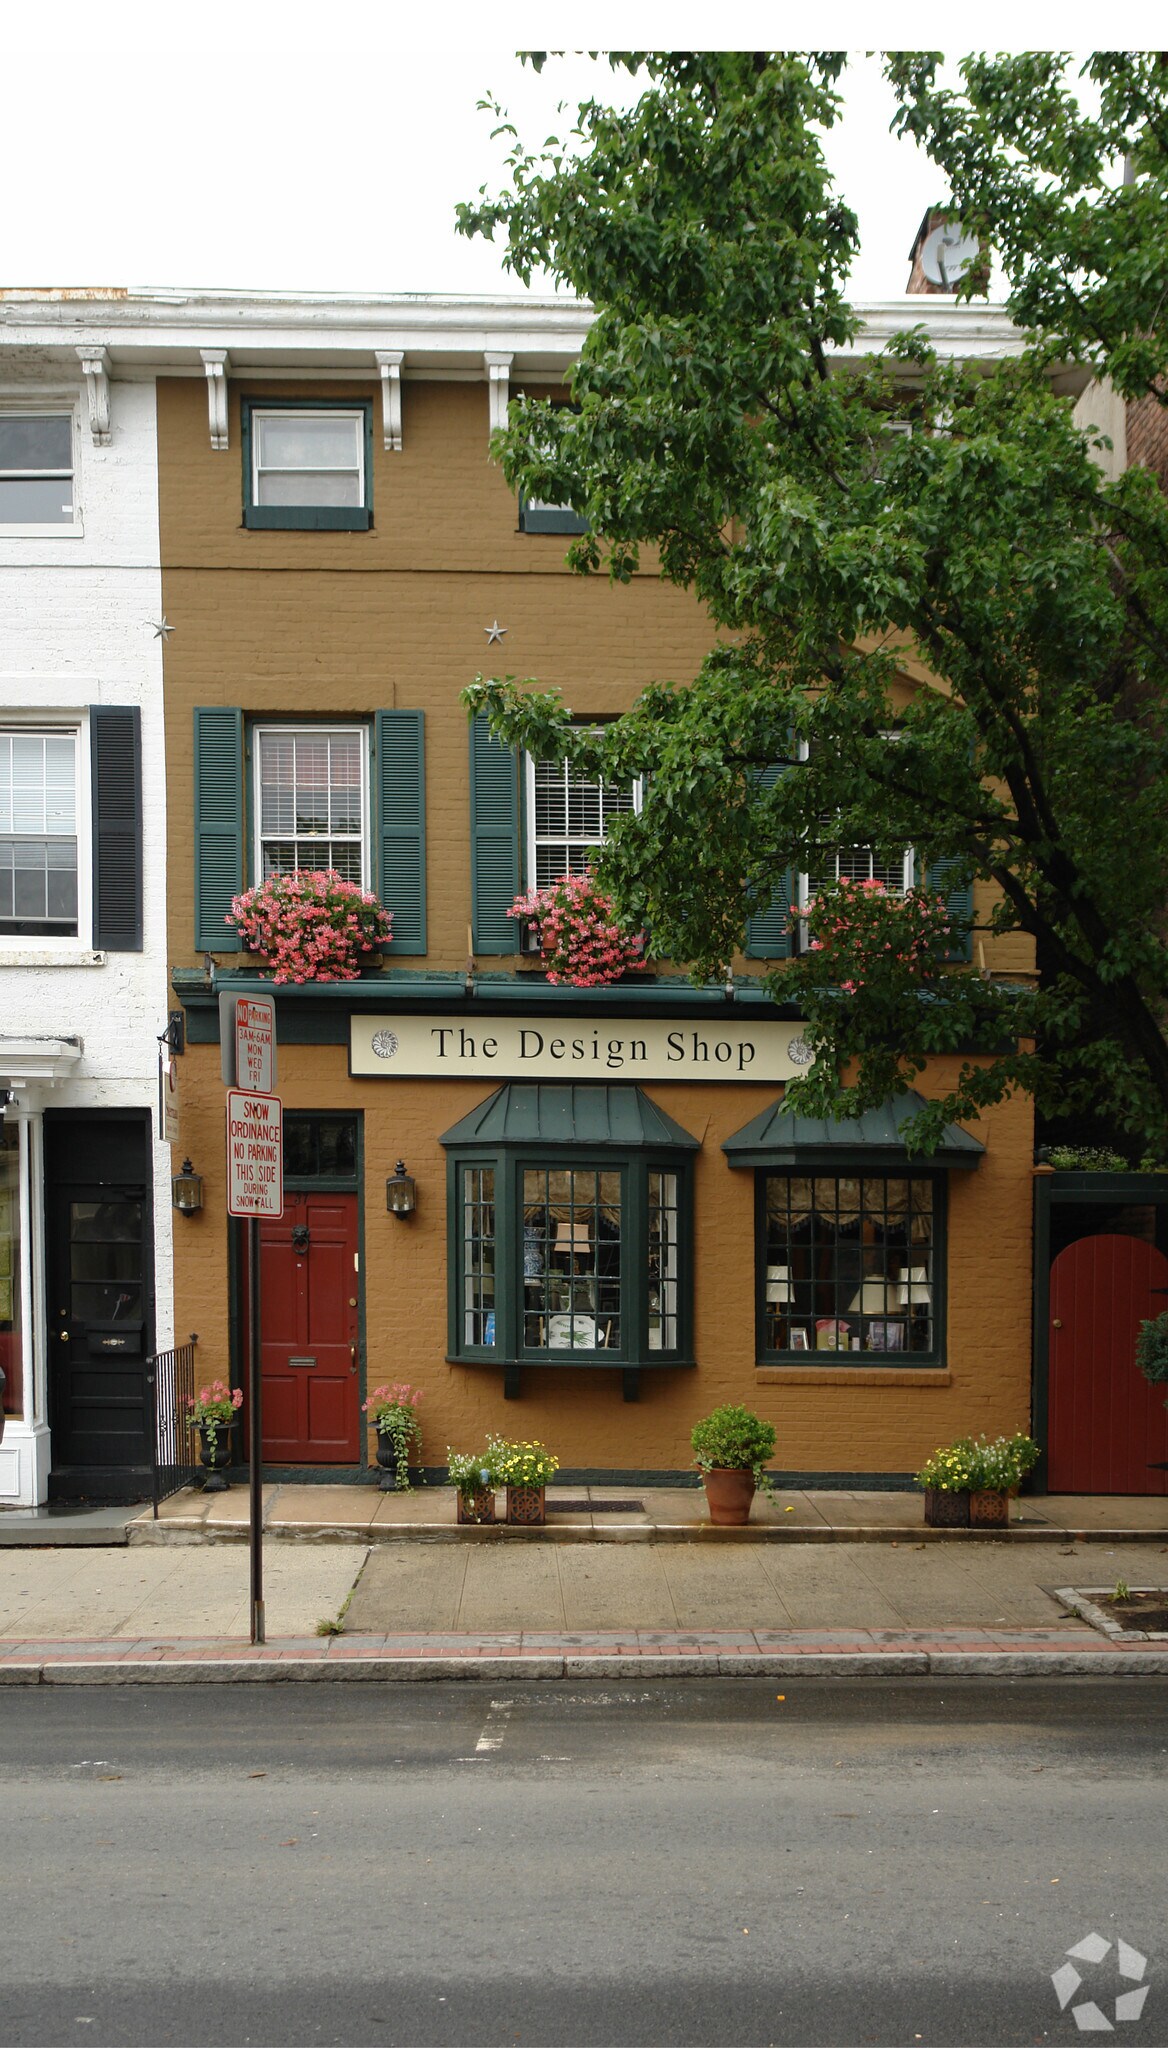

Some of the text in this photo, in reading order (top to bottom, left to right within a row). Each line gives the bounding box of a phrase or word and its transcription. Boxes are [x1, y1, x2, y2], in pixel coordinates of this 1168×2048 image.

[237, 1004, 271, 1025] NO PARKING
[430, 1028, 756, 1071] The Design Shop
[249, 1070, 260, 1083] FRI
[243, 1101, 269, 1121] SNOW
[231, 1120, 280, 1143] ORDINANCE
[234, 1142, 277, 1163] NO PARKING
[236, 1163, 276, 1183] THIS SIDE
[243, 1182, 269, 1196] DURING
[236, 1195, 274, 1209] SNOW FALL
